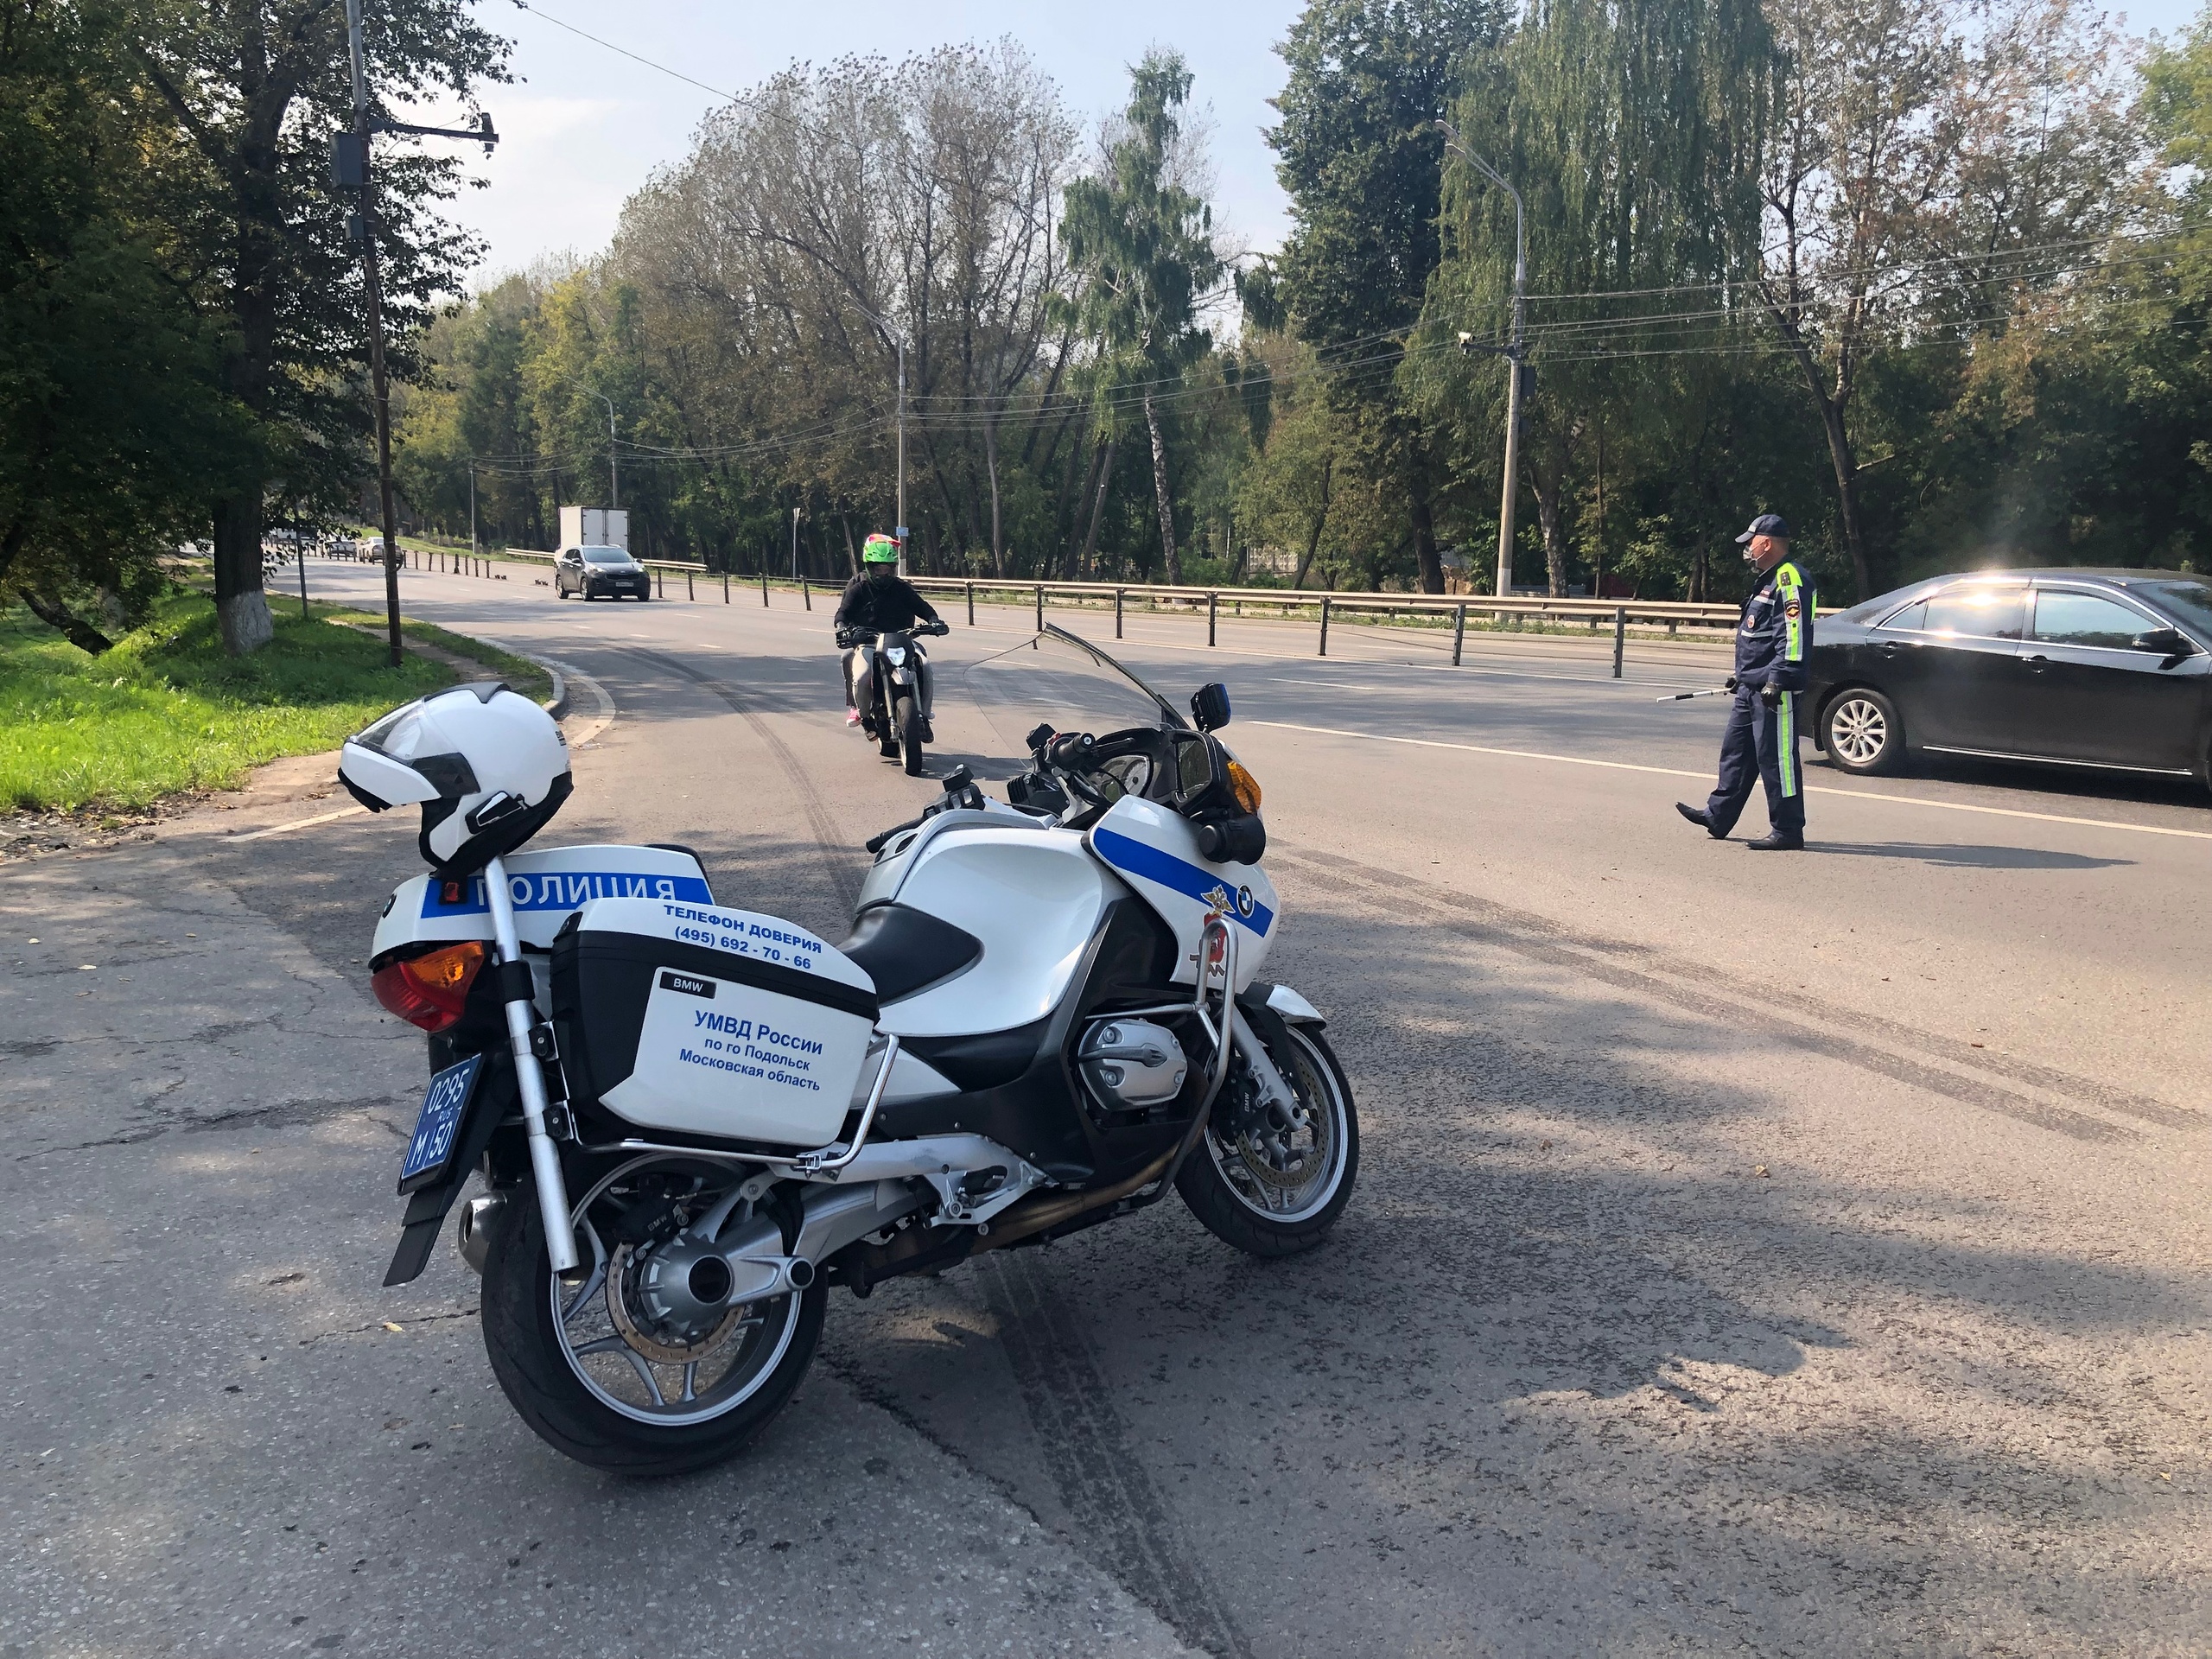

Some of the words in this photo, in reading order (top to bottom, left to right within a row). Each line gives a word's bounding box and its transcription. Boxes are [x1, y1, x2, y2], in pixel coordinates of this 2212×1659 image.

[664, 905, 745, 932] ТЕЛЕФОН
[749, 924, 822, 954] ДОВЕРИЯ
[675, 926, 715, 947] (495)
[721, 936, 749, 953] 692
[763, 947, 781, 961] 70
[793, 956, 811, 969] 66
[673, 977, 704, 993] BMW
[695, 1009, 753, 1041] УМВД
[757, 1024, 823, 1055] России
[679, 1048, 765, 1078] Московская
[767, 1070, 821, 1091] область
[704, 1039, 722, 1051] по
[727, 1043, 741, 1054] го
[744, 1045, 811, 1071] Подольск
[427, 1068, 470, 1115] 0295
[436, 1107, 454, 1123] RUS
[429, 1122, 453, 1160] 50
[647, 1213, 667, 1232] BMW
